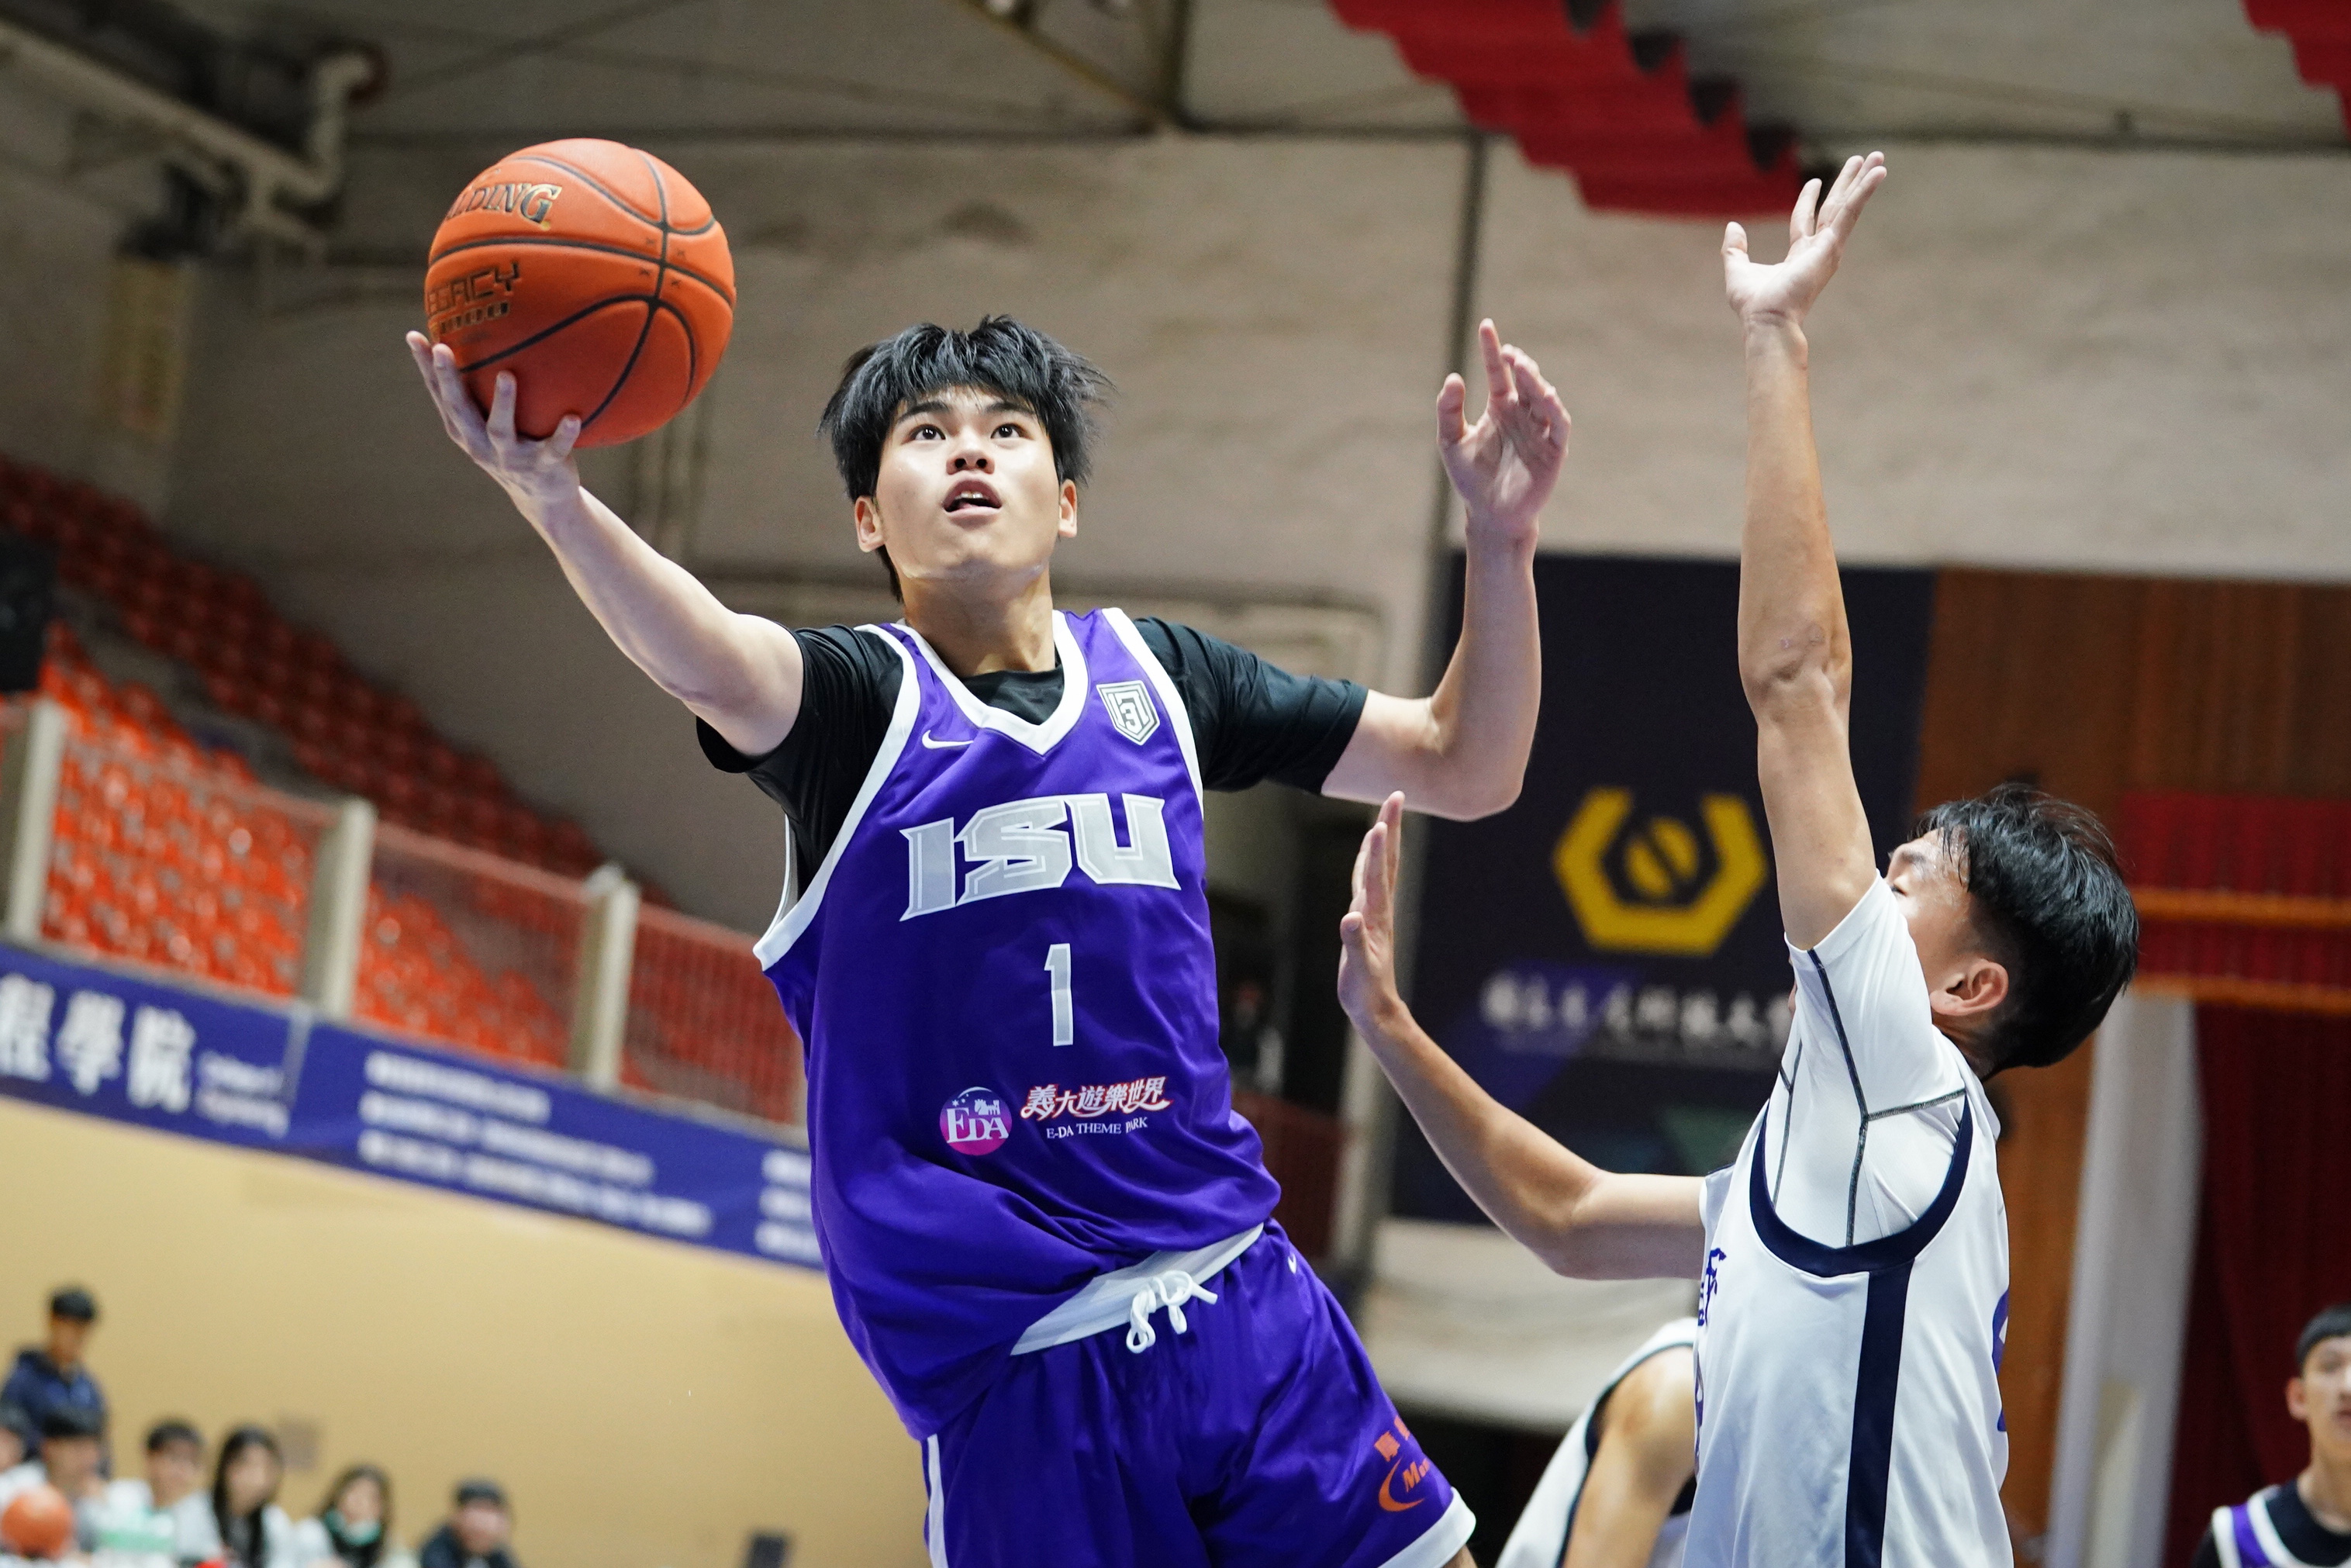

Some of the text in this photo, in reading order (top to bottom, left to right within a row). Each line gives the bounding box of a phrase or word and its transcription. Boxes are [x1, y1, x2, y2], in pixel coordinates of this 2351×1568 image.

[899, 793, 1182, 922] ISU
[1044, 943, 1074, 1047] 1
[1020, 1076, 1172, 1121] 義大遊樂世界
[945, 1107, 1010, 1144] EDA
[1047, 1116, 1148, 1140] E-DA THEME PARK
